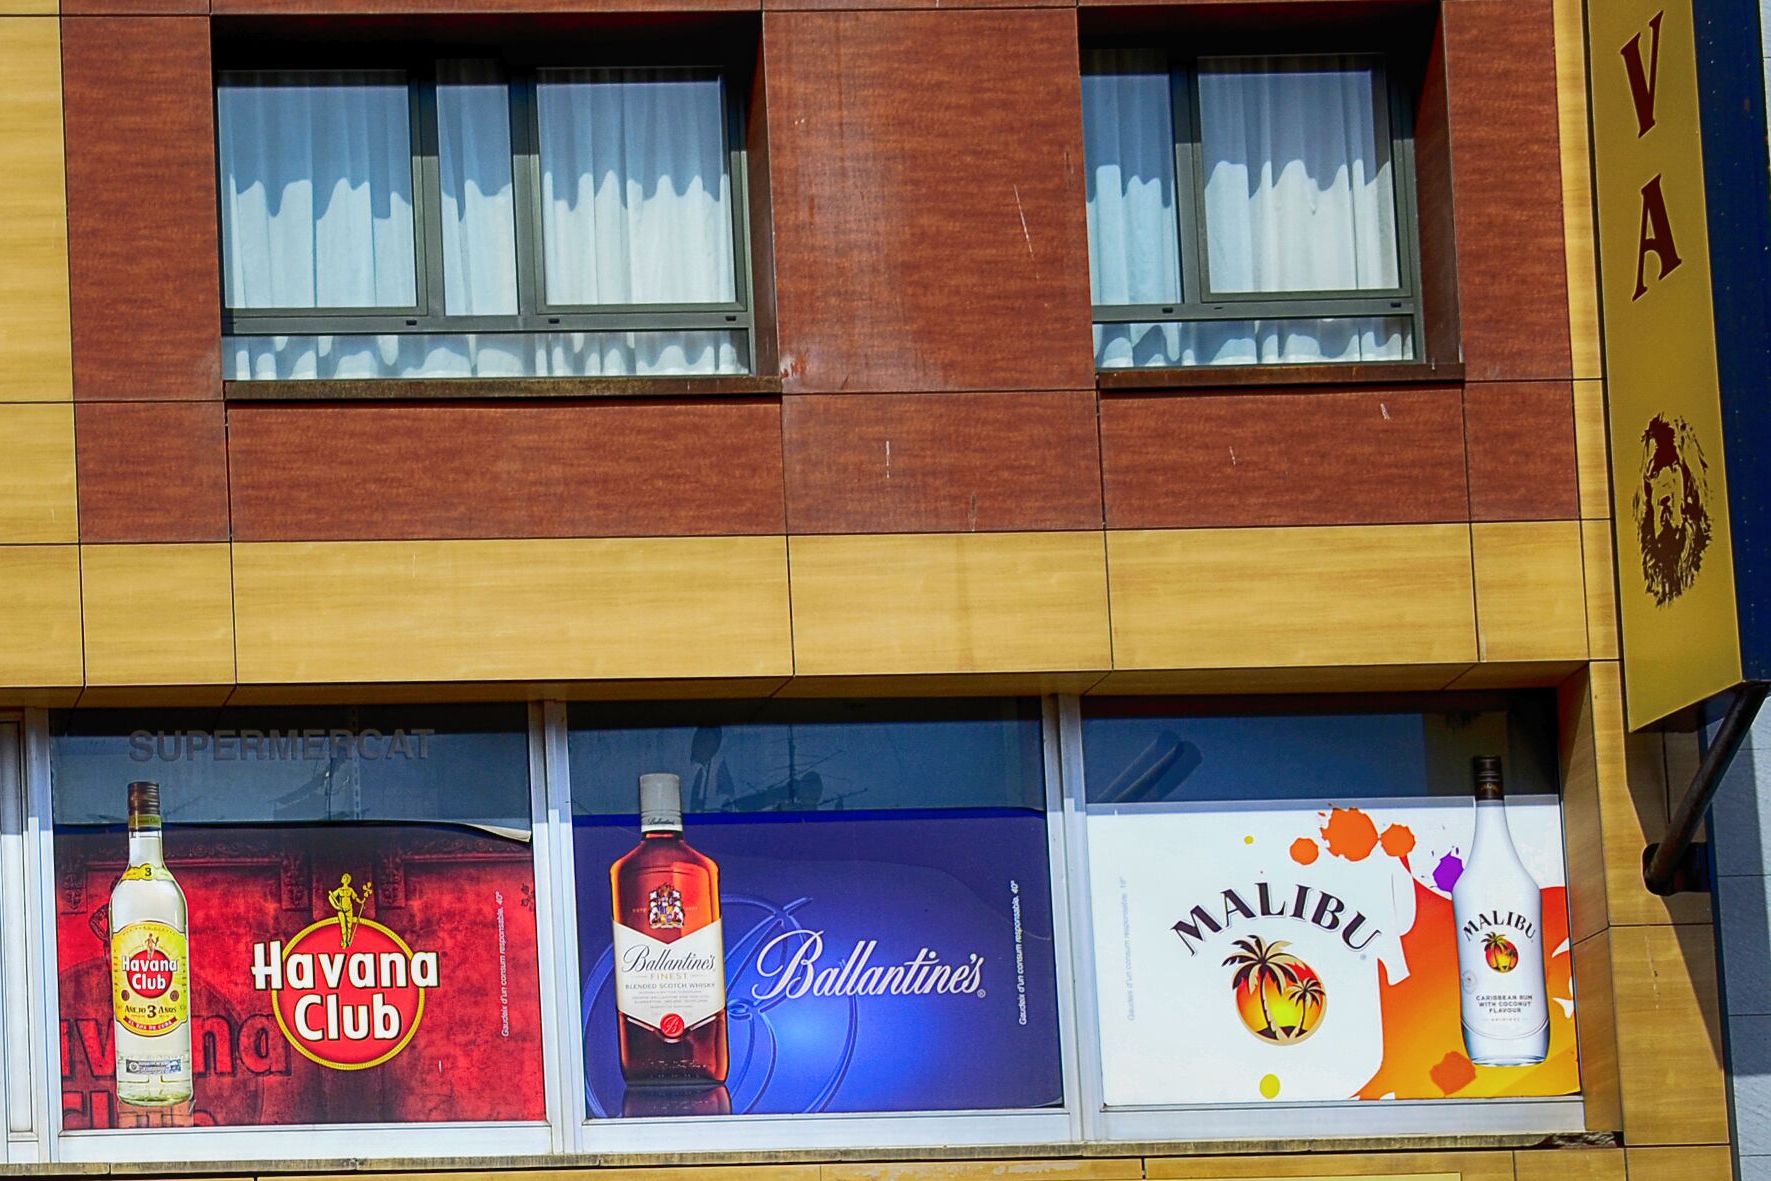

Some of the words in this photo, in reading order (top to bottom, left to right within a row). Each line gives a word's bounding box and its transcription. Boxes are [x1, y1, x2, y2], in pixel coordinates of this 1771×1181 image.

[127, 728, 436, 762] SUPERMERCAT
[144, 867, 152, 877] 3
[1170, 882, 1383, 957] MALIBU
[1463, 910, 1535, 942] MALIBU
[122, 956, 178, 972] Havana
[252, 940, 440, 990] Havana
[499, 955, 507, 986] consum
[621, 944, 716, 973] Ballantine's
[751, 929, 984, 1000] Ballantine's
[1016, 944, 1024, 974] consum
[131, 973, 167, 990] Club
[499, 987, 507, 1005] d'un
[1017, 975, 1025, 993] d'un
[147, 1004, 157, 1018] 3
[295, 994, 402, 1041] Club
[501, 1006, 509, 1037] Gaudeix
[1018, 994, 1027, 1025] Gaudeix
